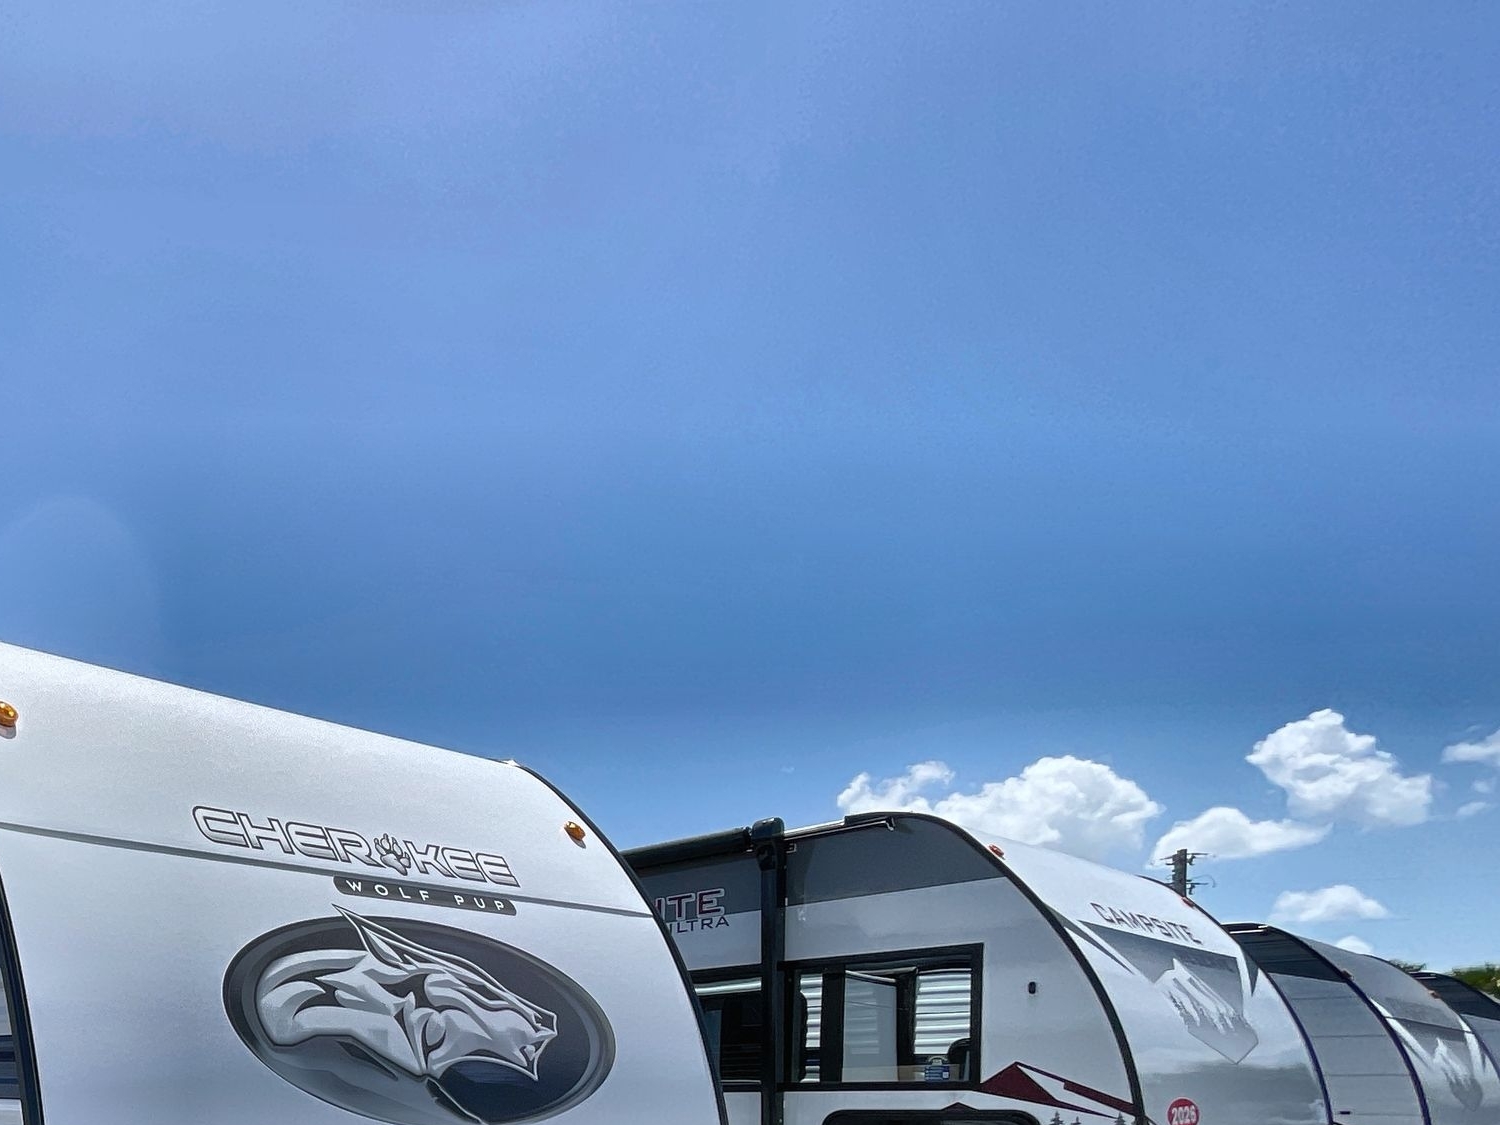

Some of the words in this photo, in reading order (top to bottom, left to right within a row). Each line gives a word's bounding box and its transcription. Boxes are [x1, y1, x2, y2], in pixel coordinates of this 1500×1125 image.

[346, 879, 431, 901] WOLF
[454, 893, 506, 911] PUP
[1090, 902, 1203, 946] CAMPSITE
[1171, 1104, 1197, 1125] 2026
